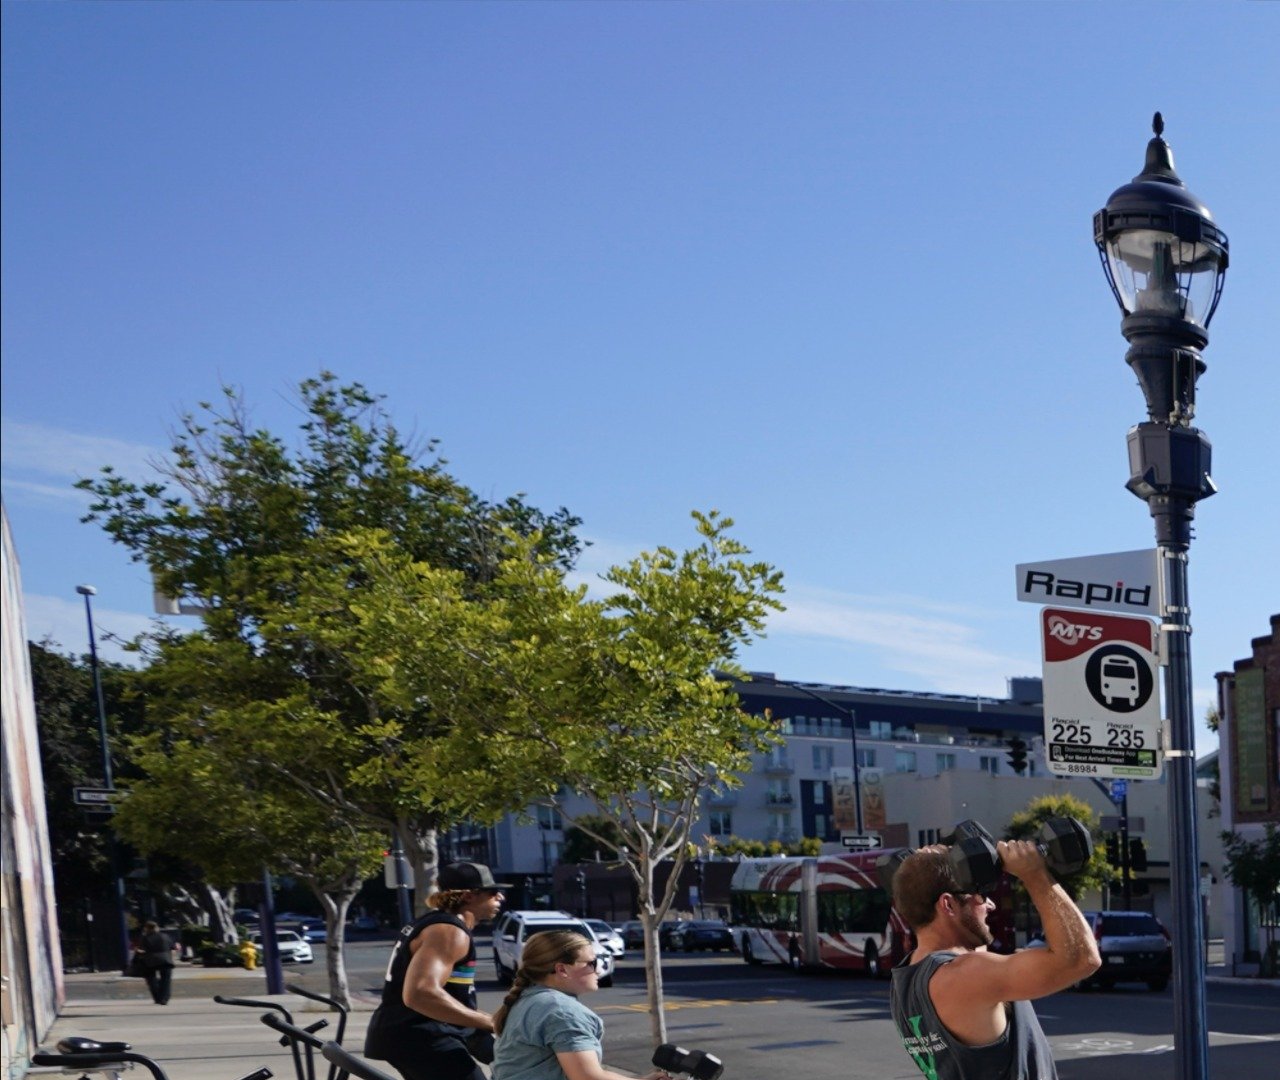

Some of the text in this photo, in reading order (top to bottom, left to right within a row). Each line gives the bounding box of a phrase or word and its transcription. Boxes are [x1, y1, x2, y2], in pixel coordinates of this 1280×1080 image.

[1024, 571, 1151, 605] Rapid
[1050, 623, 1103, 640] MTS
[1052, 717, 1133, 730] Rapid Rapid
[1052, 724, 1145, 749] 225 235
[1068, 764, 1097, 773] 88984
